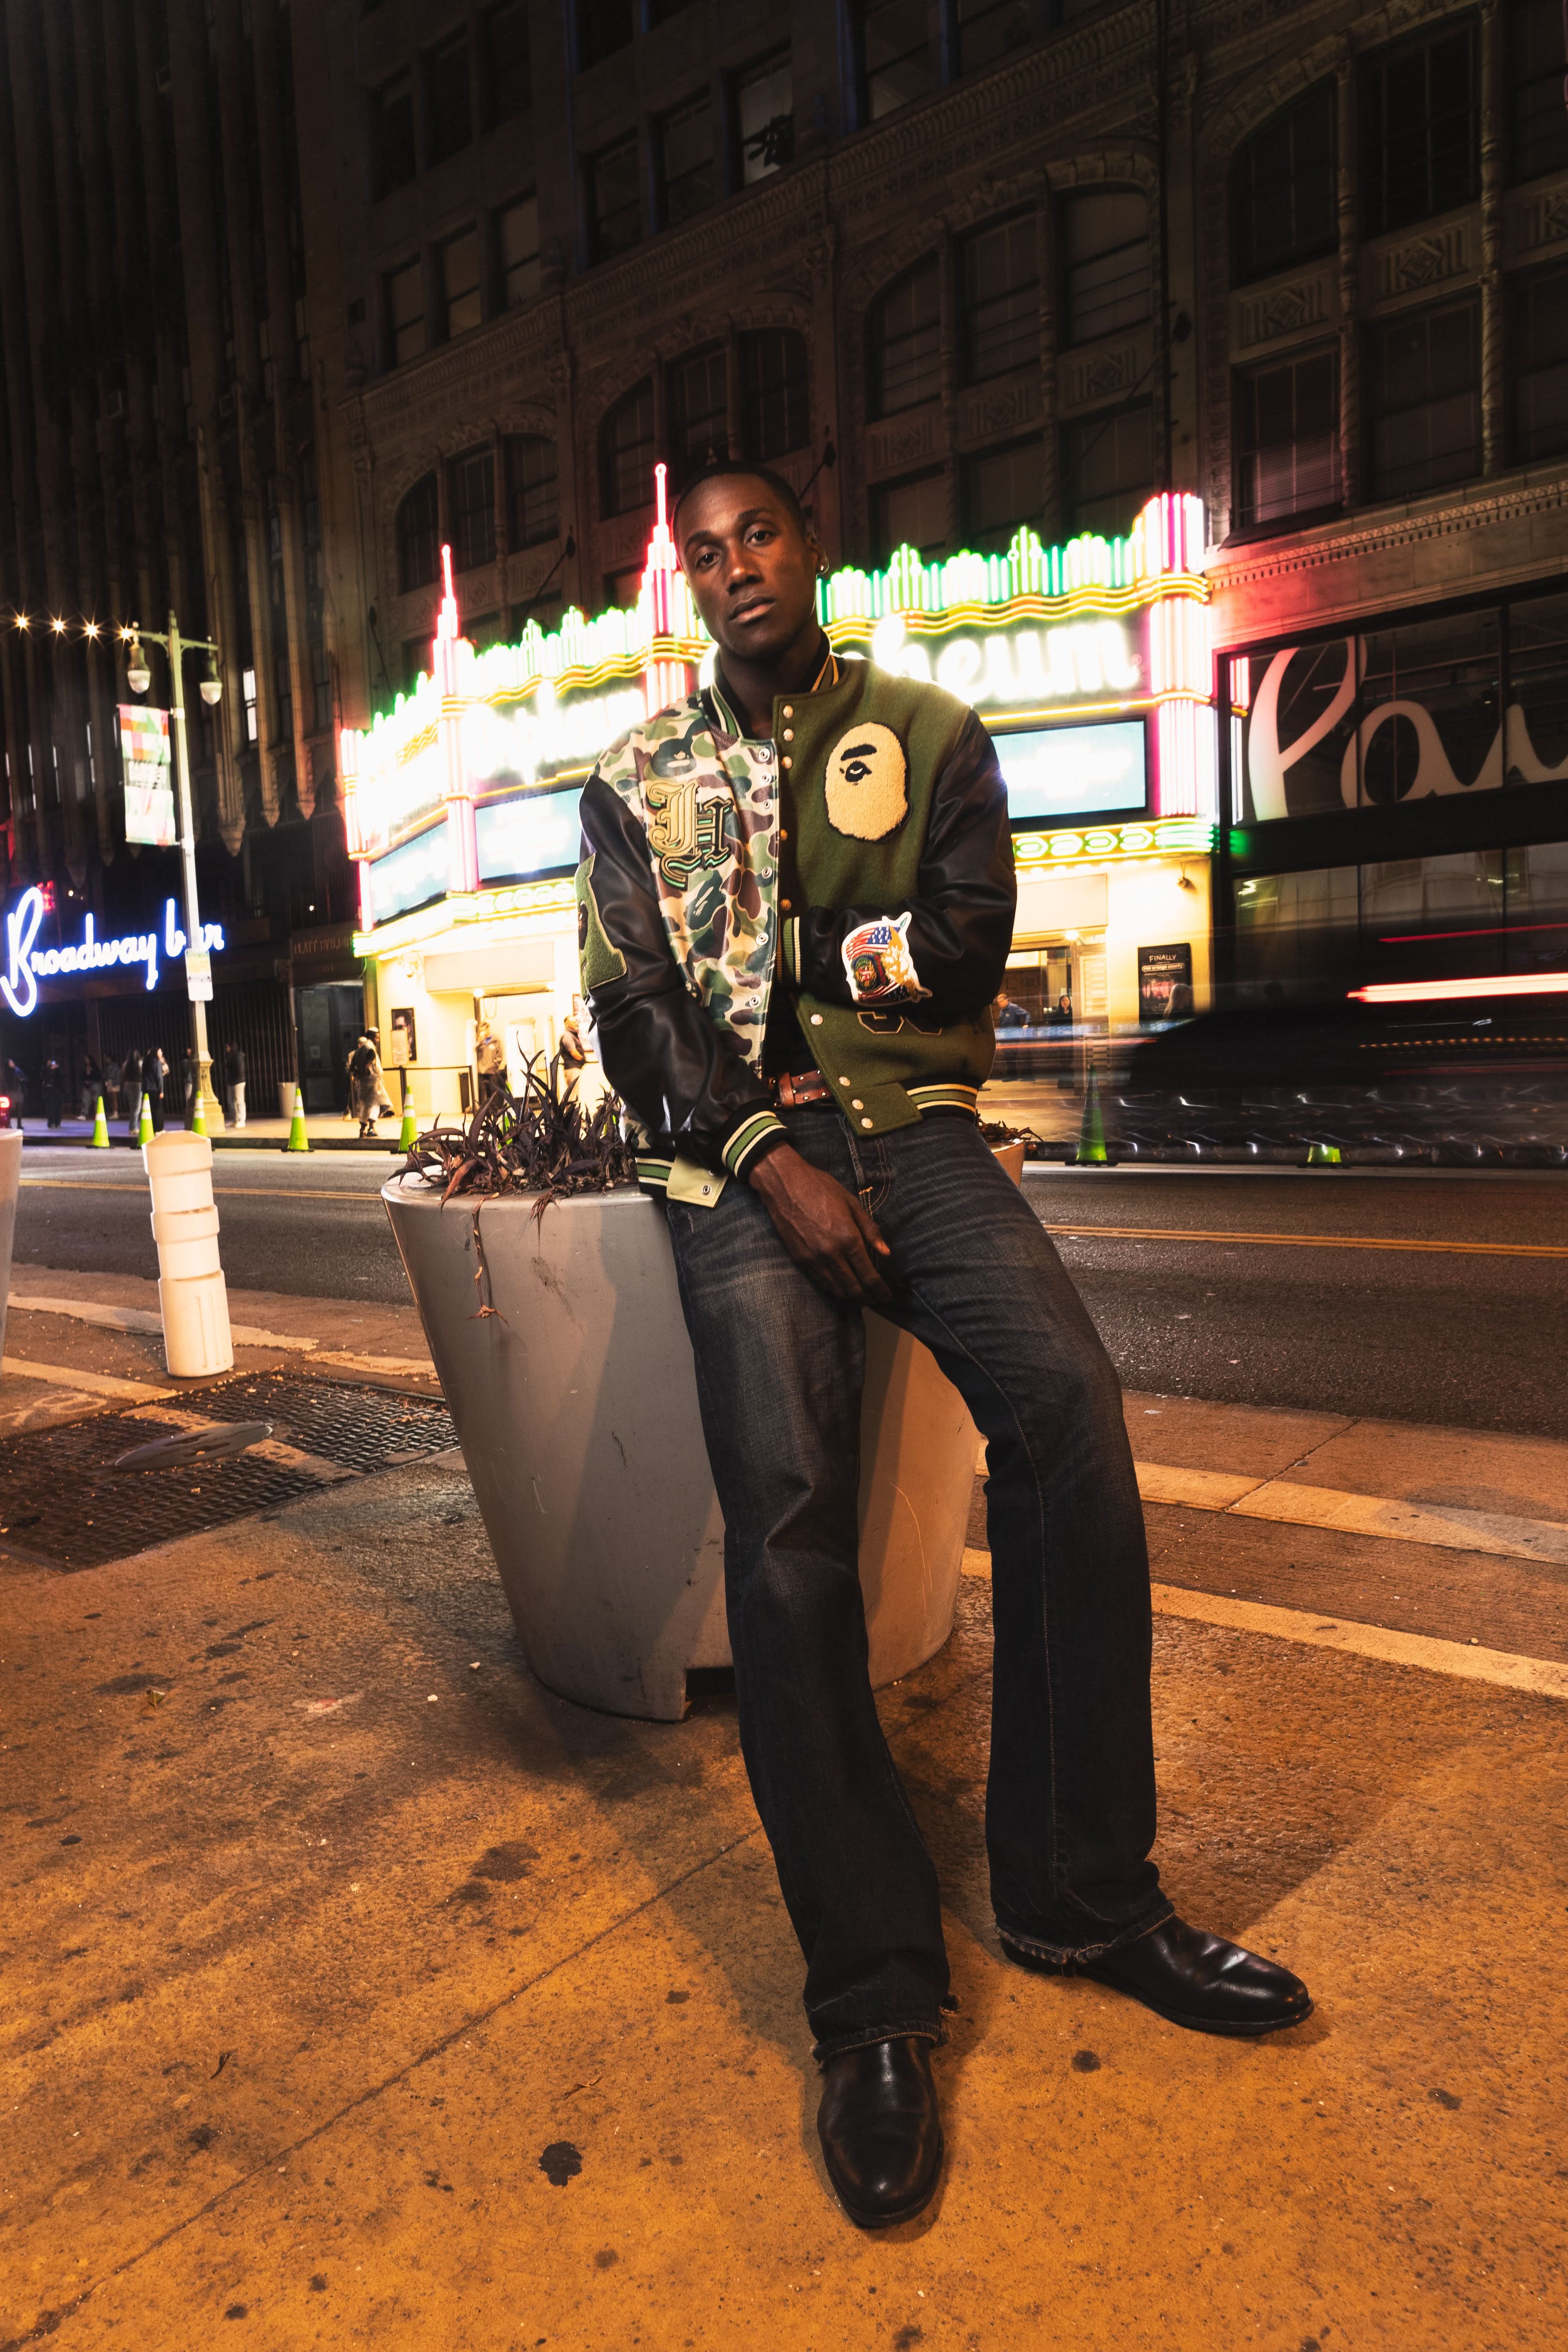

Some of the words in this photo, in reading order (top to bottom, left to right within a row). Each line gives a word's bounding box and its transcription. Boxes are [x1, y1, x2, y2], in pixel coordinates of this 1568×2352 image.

[841, 613, 1139, 704] heum
[0, 886, 159, 1017] Broadway
[1148, 954, 1176, 962] FINALLY
